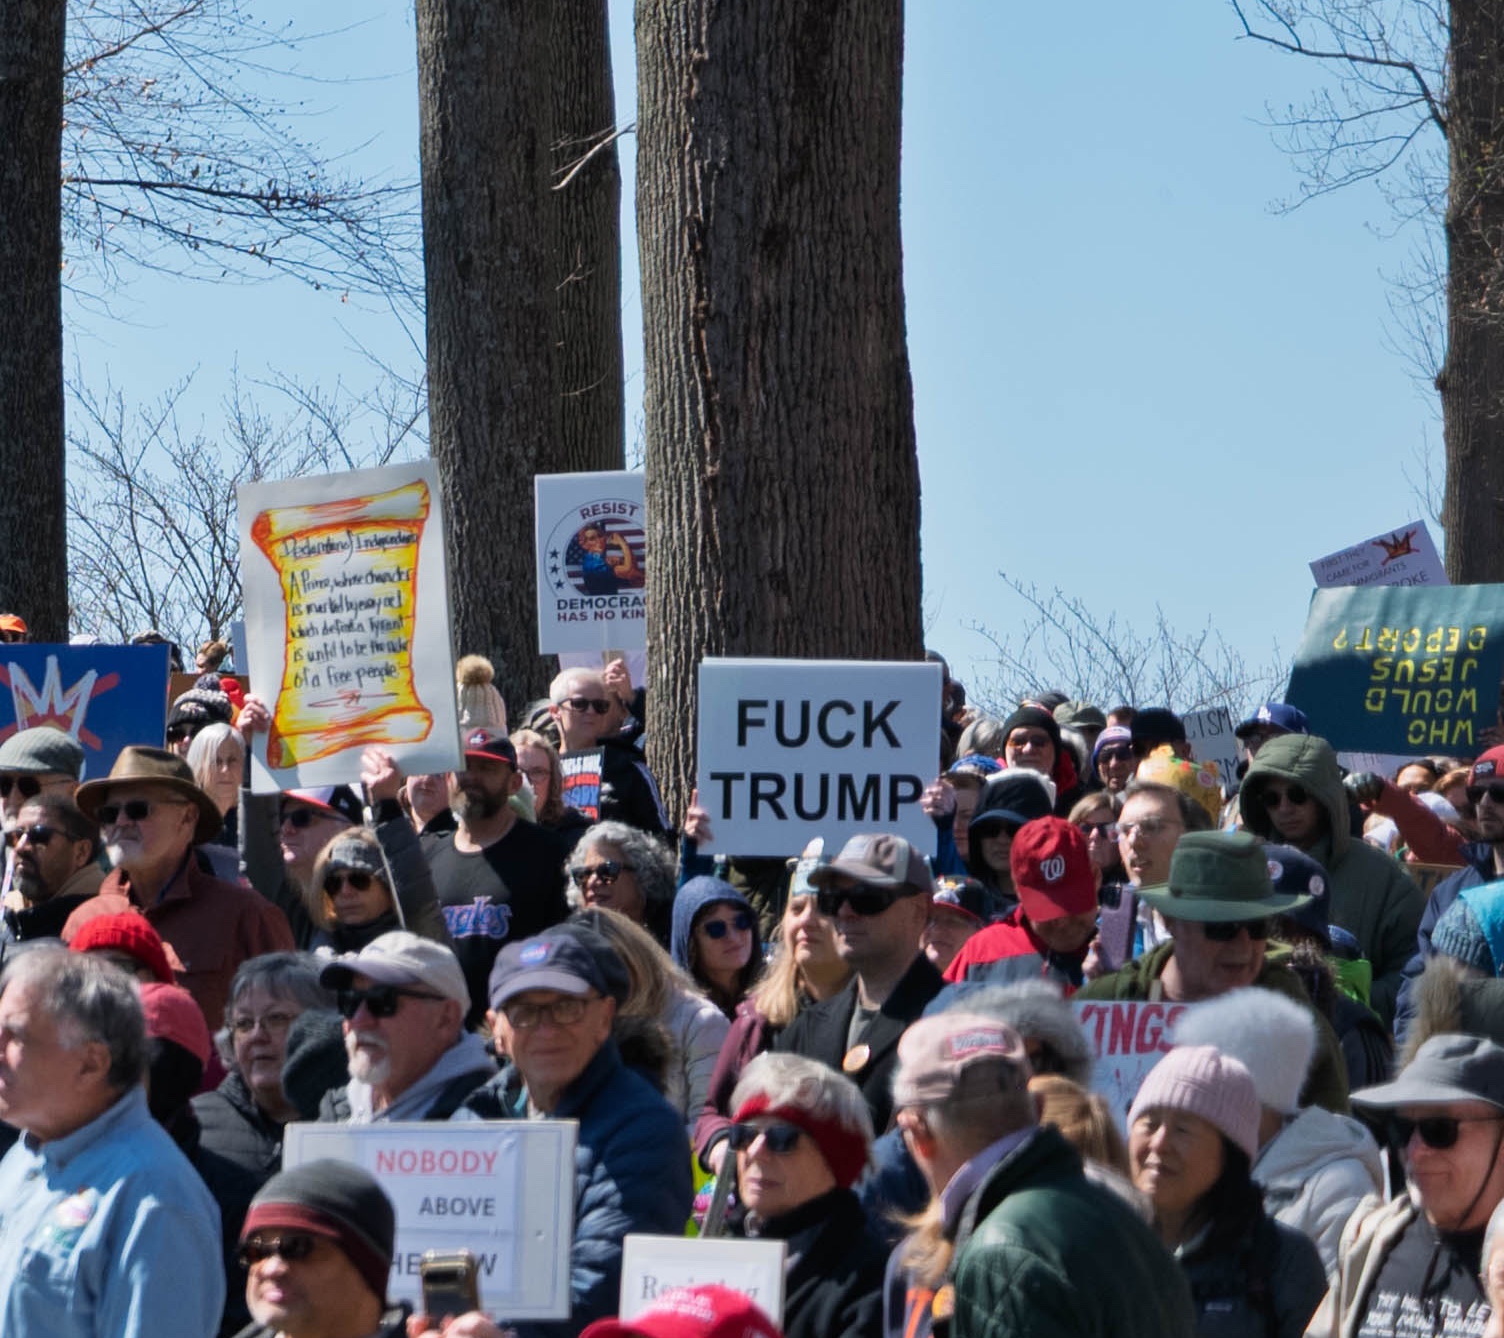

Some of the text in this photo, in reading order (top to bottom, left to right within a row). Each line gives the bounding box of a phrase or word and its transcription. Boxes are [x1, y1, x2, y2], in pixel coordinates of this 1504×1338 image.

[579, 502, 639, 520] RESIST
[557, 596, 645, 610] DEMOCRA
[557, 609, 645, 622] HAS NO KIN
[1371, 658, 1478, 683] JESUS
[1365, 688, 1478, 714] WOULD
[737, 699, 902, 748] FUCK
[1184, 707, 1233, 738] CISM
[1408, 719, 1474, 745] WHO
[710, 772, 923, 821] TRUMP
[441, 896, 513, 939] agles
[376, 1150, 498, 1174] NOBODY
[419, 1196, 496, 1217] ABOVE
[393, 1253, 420, 1275] HE
